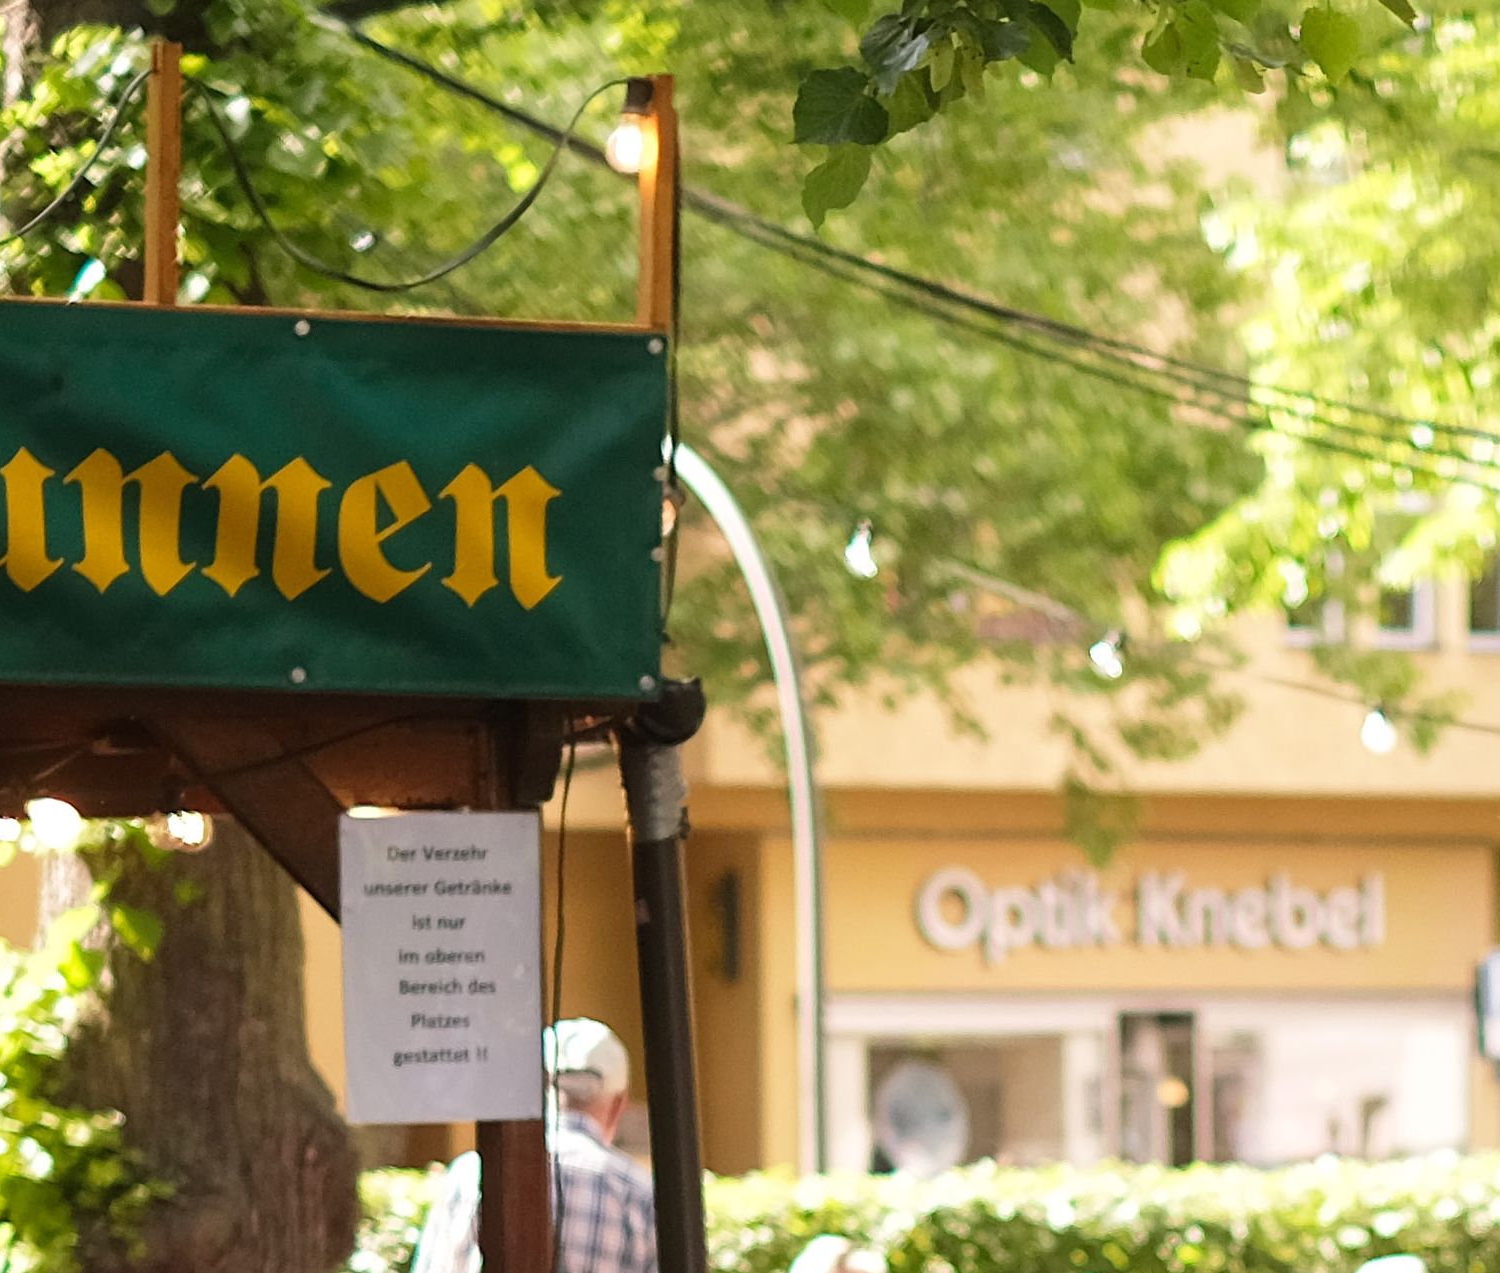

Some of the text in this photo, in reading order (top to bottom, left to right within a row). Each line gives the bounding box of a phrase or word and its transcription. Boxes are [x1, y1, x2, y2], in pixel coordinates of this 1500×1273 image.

[387, 846, 488, 861] Der Verzehr
[364, 880, 512, 896] unserer Getränke
[412, 914, 465, 930] ist nur
[917, 867, 1388, 964] Optik Knebel
[399, 949, 485, 964] im oberen
[399, 979, 496, 995] Bereich des
[411, 1013, 470, 1029] Platzes
[393, 1048, 469, 1067] gestattet
